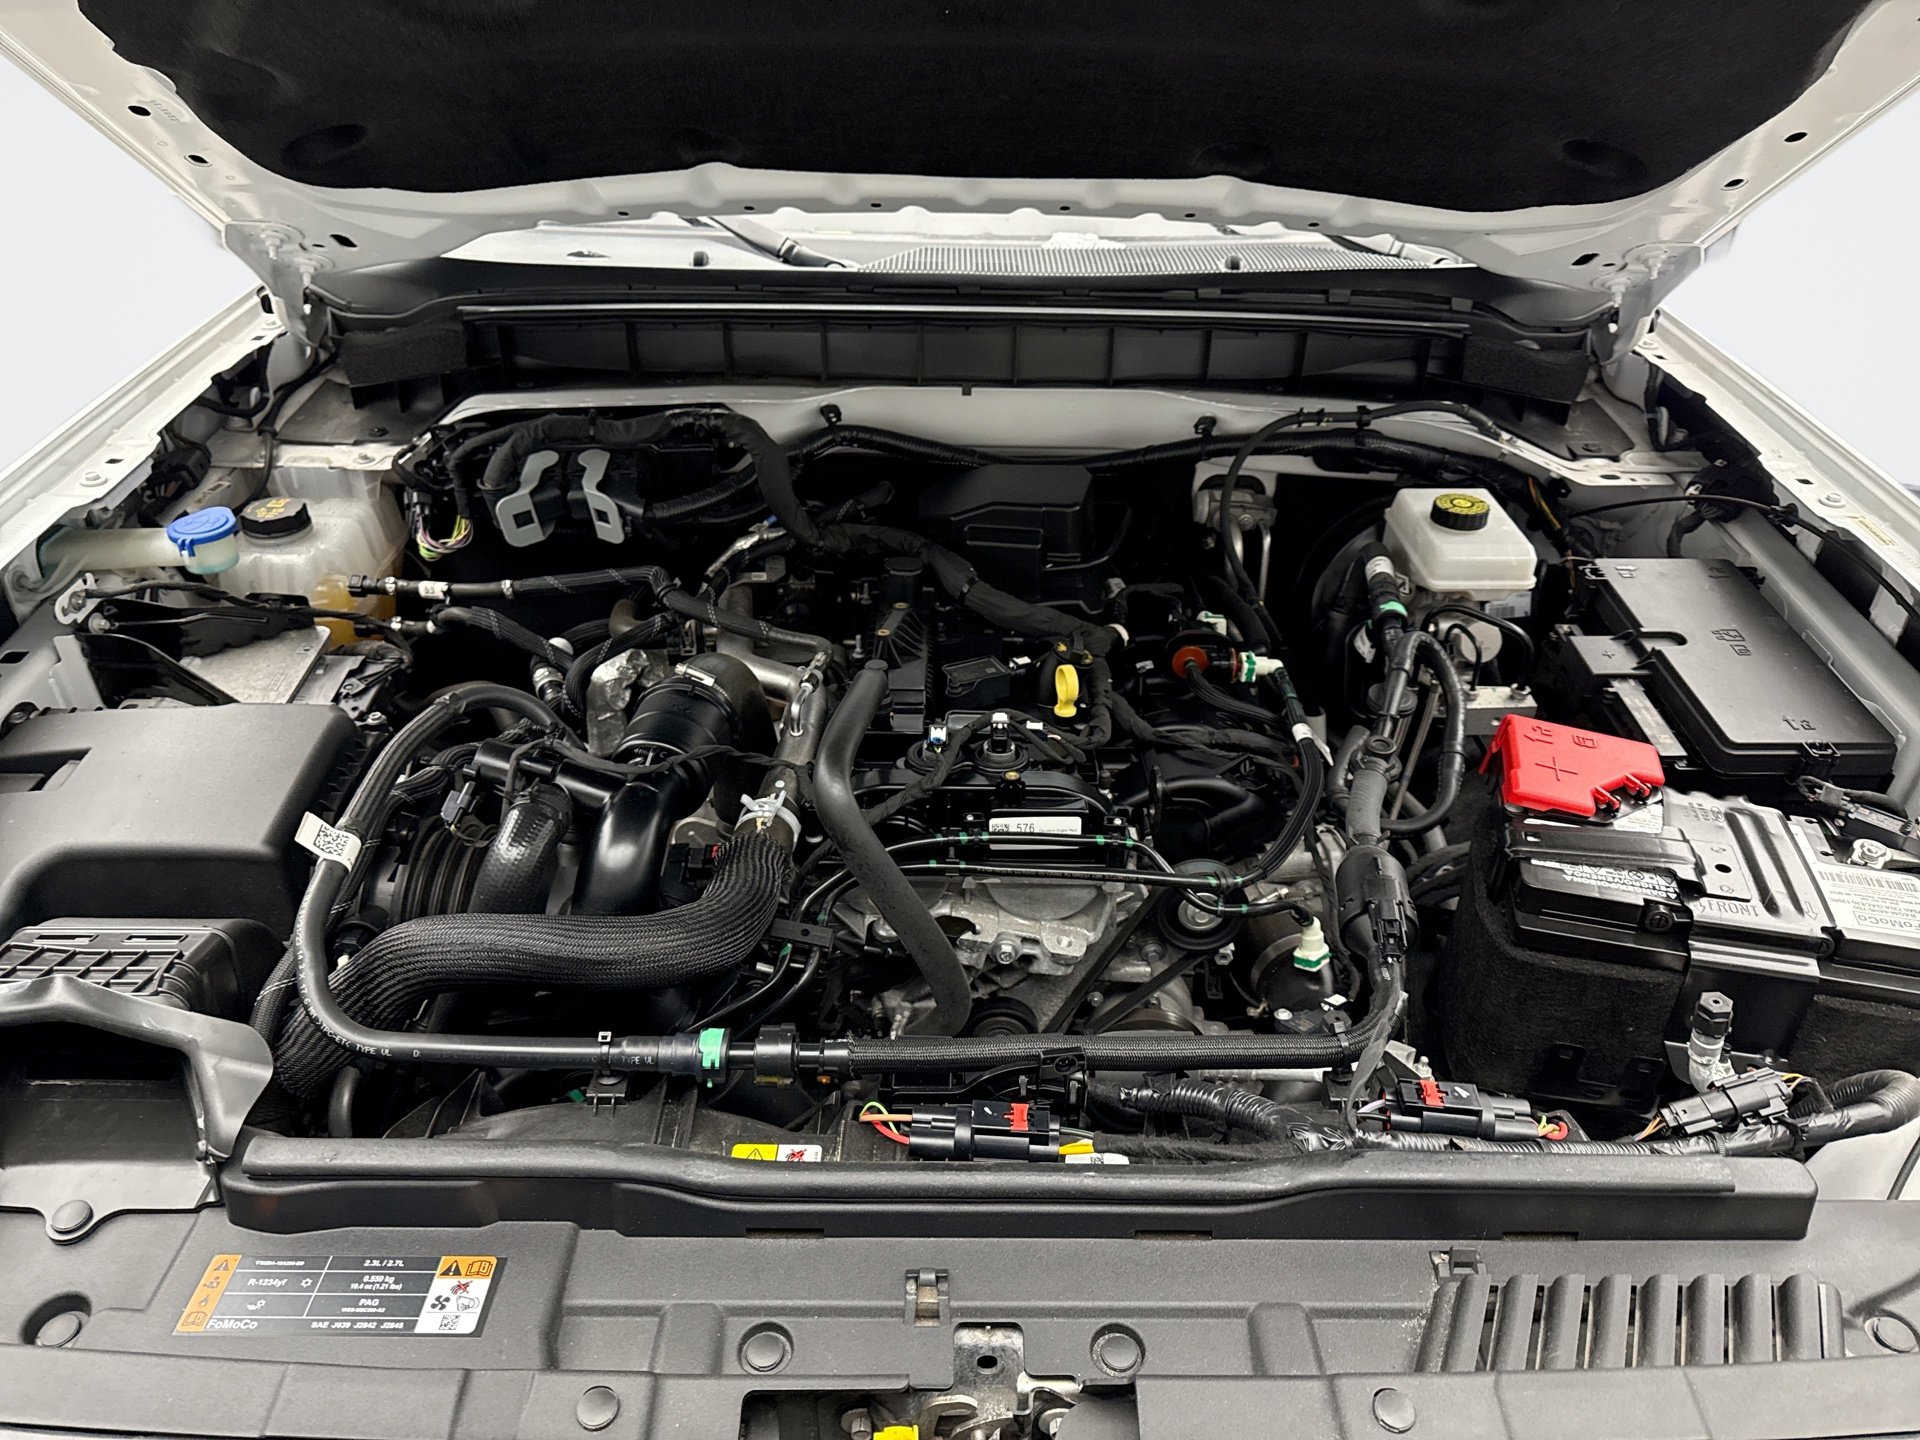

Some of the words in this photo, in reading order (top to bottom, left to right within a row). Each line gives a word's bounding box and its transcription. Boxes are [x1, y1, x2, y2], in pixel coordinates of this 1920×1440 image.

[1016, 823, 1035, 833] 576
[1708, 900, 1760, 917] FRONT
[355, 1043, 377, 1056] TYPE
[387, 1259, 405, 1268] 2.7L
[247, 1278, 288, 1288] R-1234yf
[384, 1275, 396, 1285] kg
[358, 1298, 380, 1307] PAG
[206, 1319, 258, 1330] FoMoCo
[310, 1321, 330, 1329] SAE
